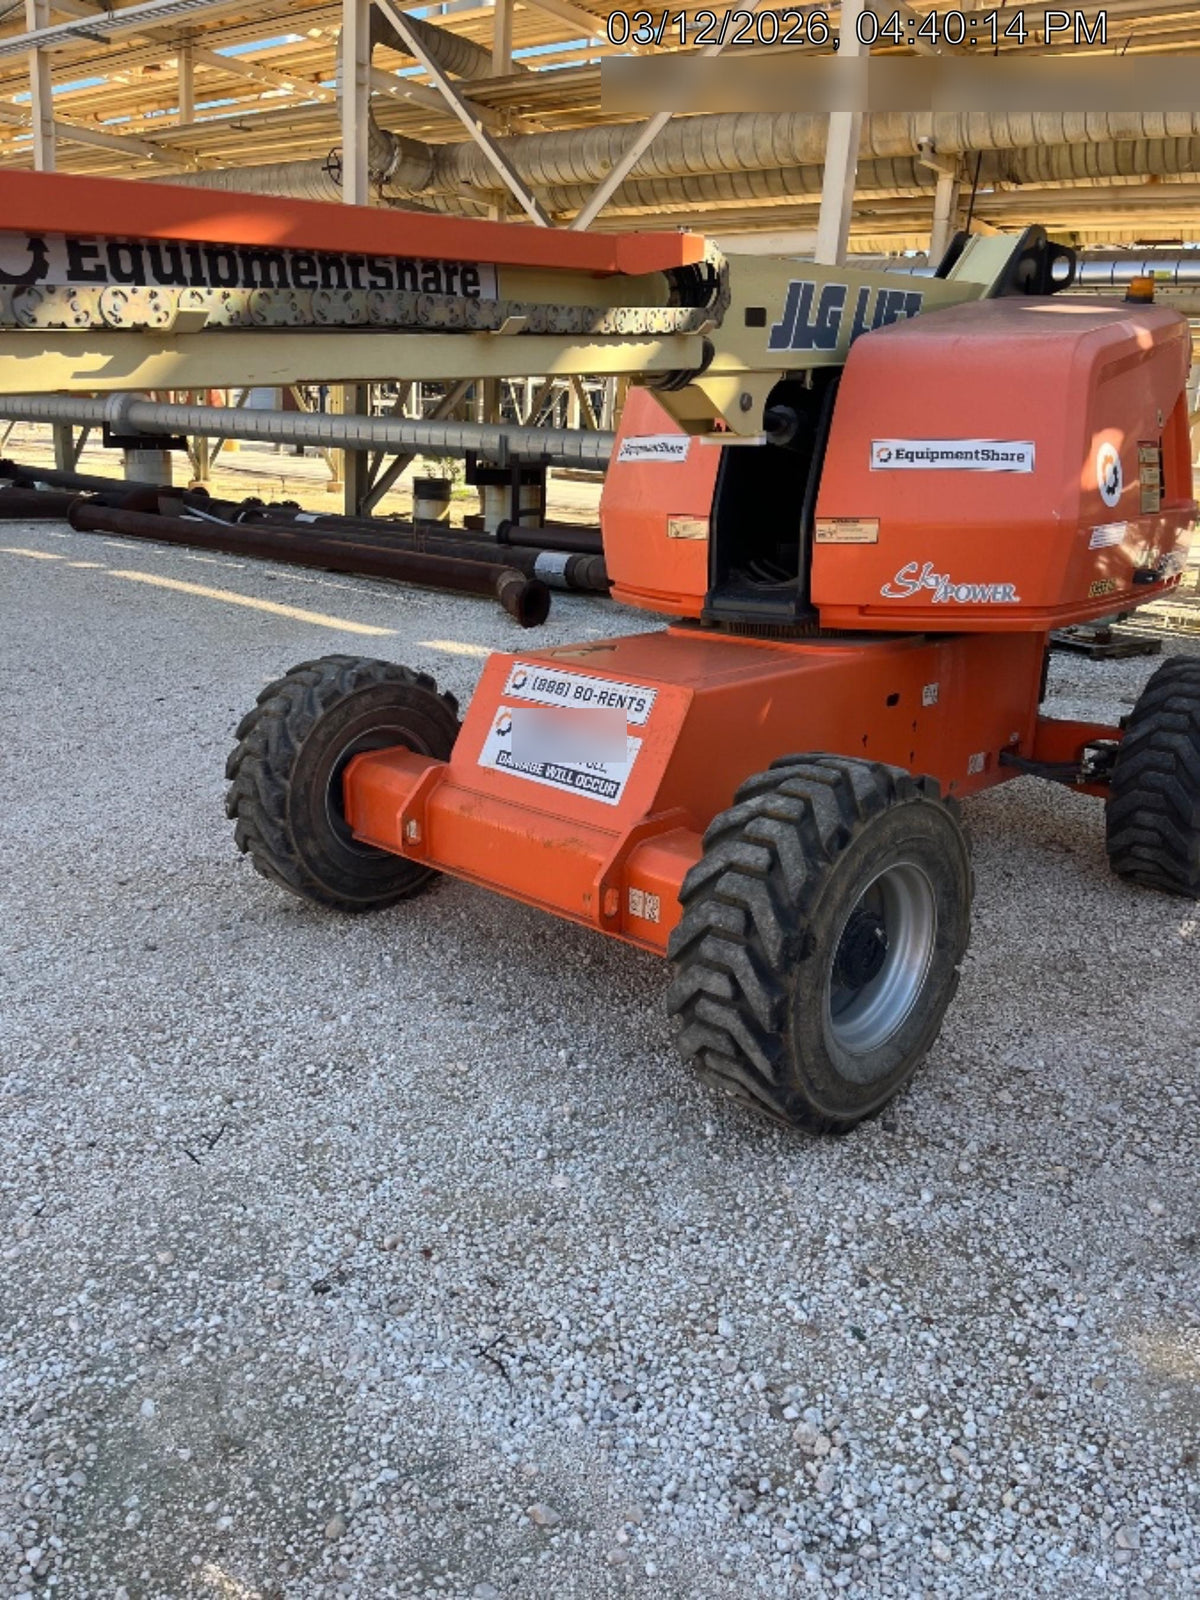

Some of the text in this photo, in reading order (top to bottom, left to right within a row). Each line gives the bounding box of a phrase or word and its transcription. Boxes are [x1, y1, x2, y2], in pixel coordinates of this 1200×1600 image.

[67, 238, 481, 298] EquipmentShare
[766, 279, 848, 352] JLG
[895, 448, 1026, 463] EquipmentShare
[573, 686, 646, 713] 80-RENTS
[545, 765, 574, 783] WILL
[575, 774, 618, 797] OCCUR
